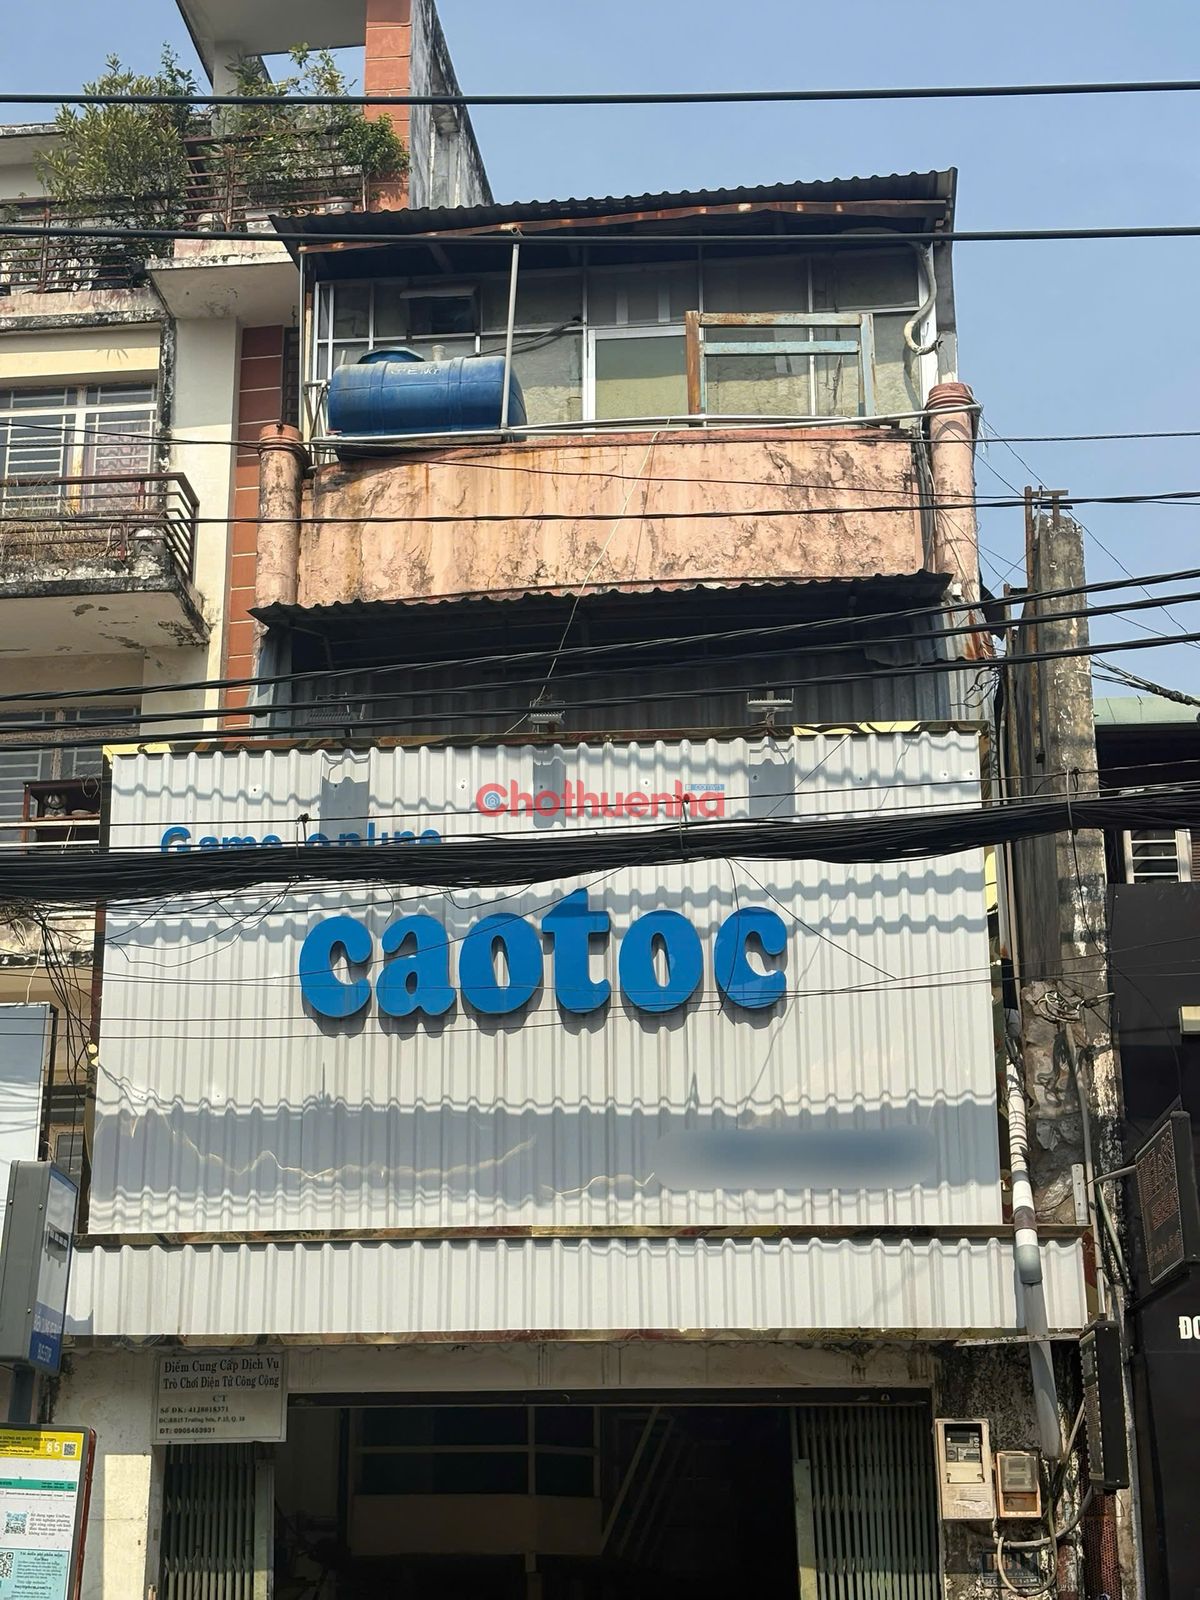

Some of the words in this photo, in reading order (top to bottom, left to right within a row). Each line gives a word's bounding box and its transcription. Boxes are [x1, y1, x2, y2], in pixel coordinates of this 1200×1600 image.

[298, 887, 788, 1018] caotoc
[164, 1360, 189, 1373] Điểm
[192, 1360, 218, 1374] Cung
[220, 1359, 239, 1373] Cấp
[241, 1358, 263, 1372] Dịch
[266, 1357, 279, 1372] Vụ
[163, 1378, 178, 1389] Trò
[201, 1376, 220, 1390] Điện
[235, 1375, 257, 1389] Công
[258, 1374, 280, 1389] Cộng
